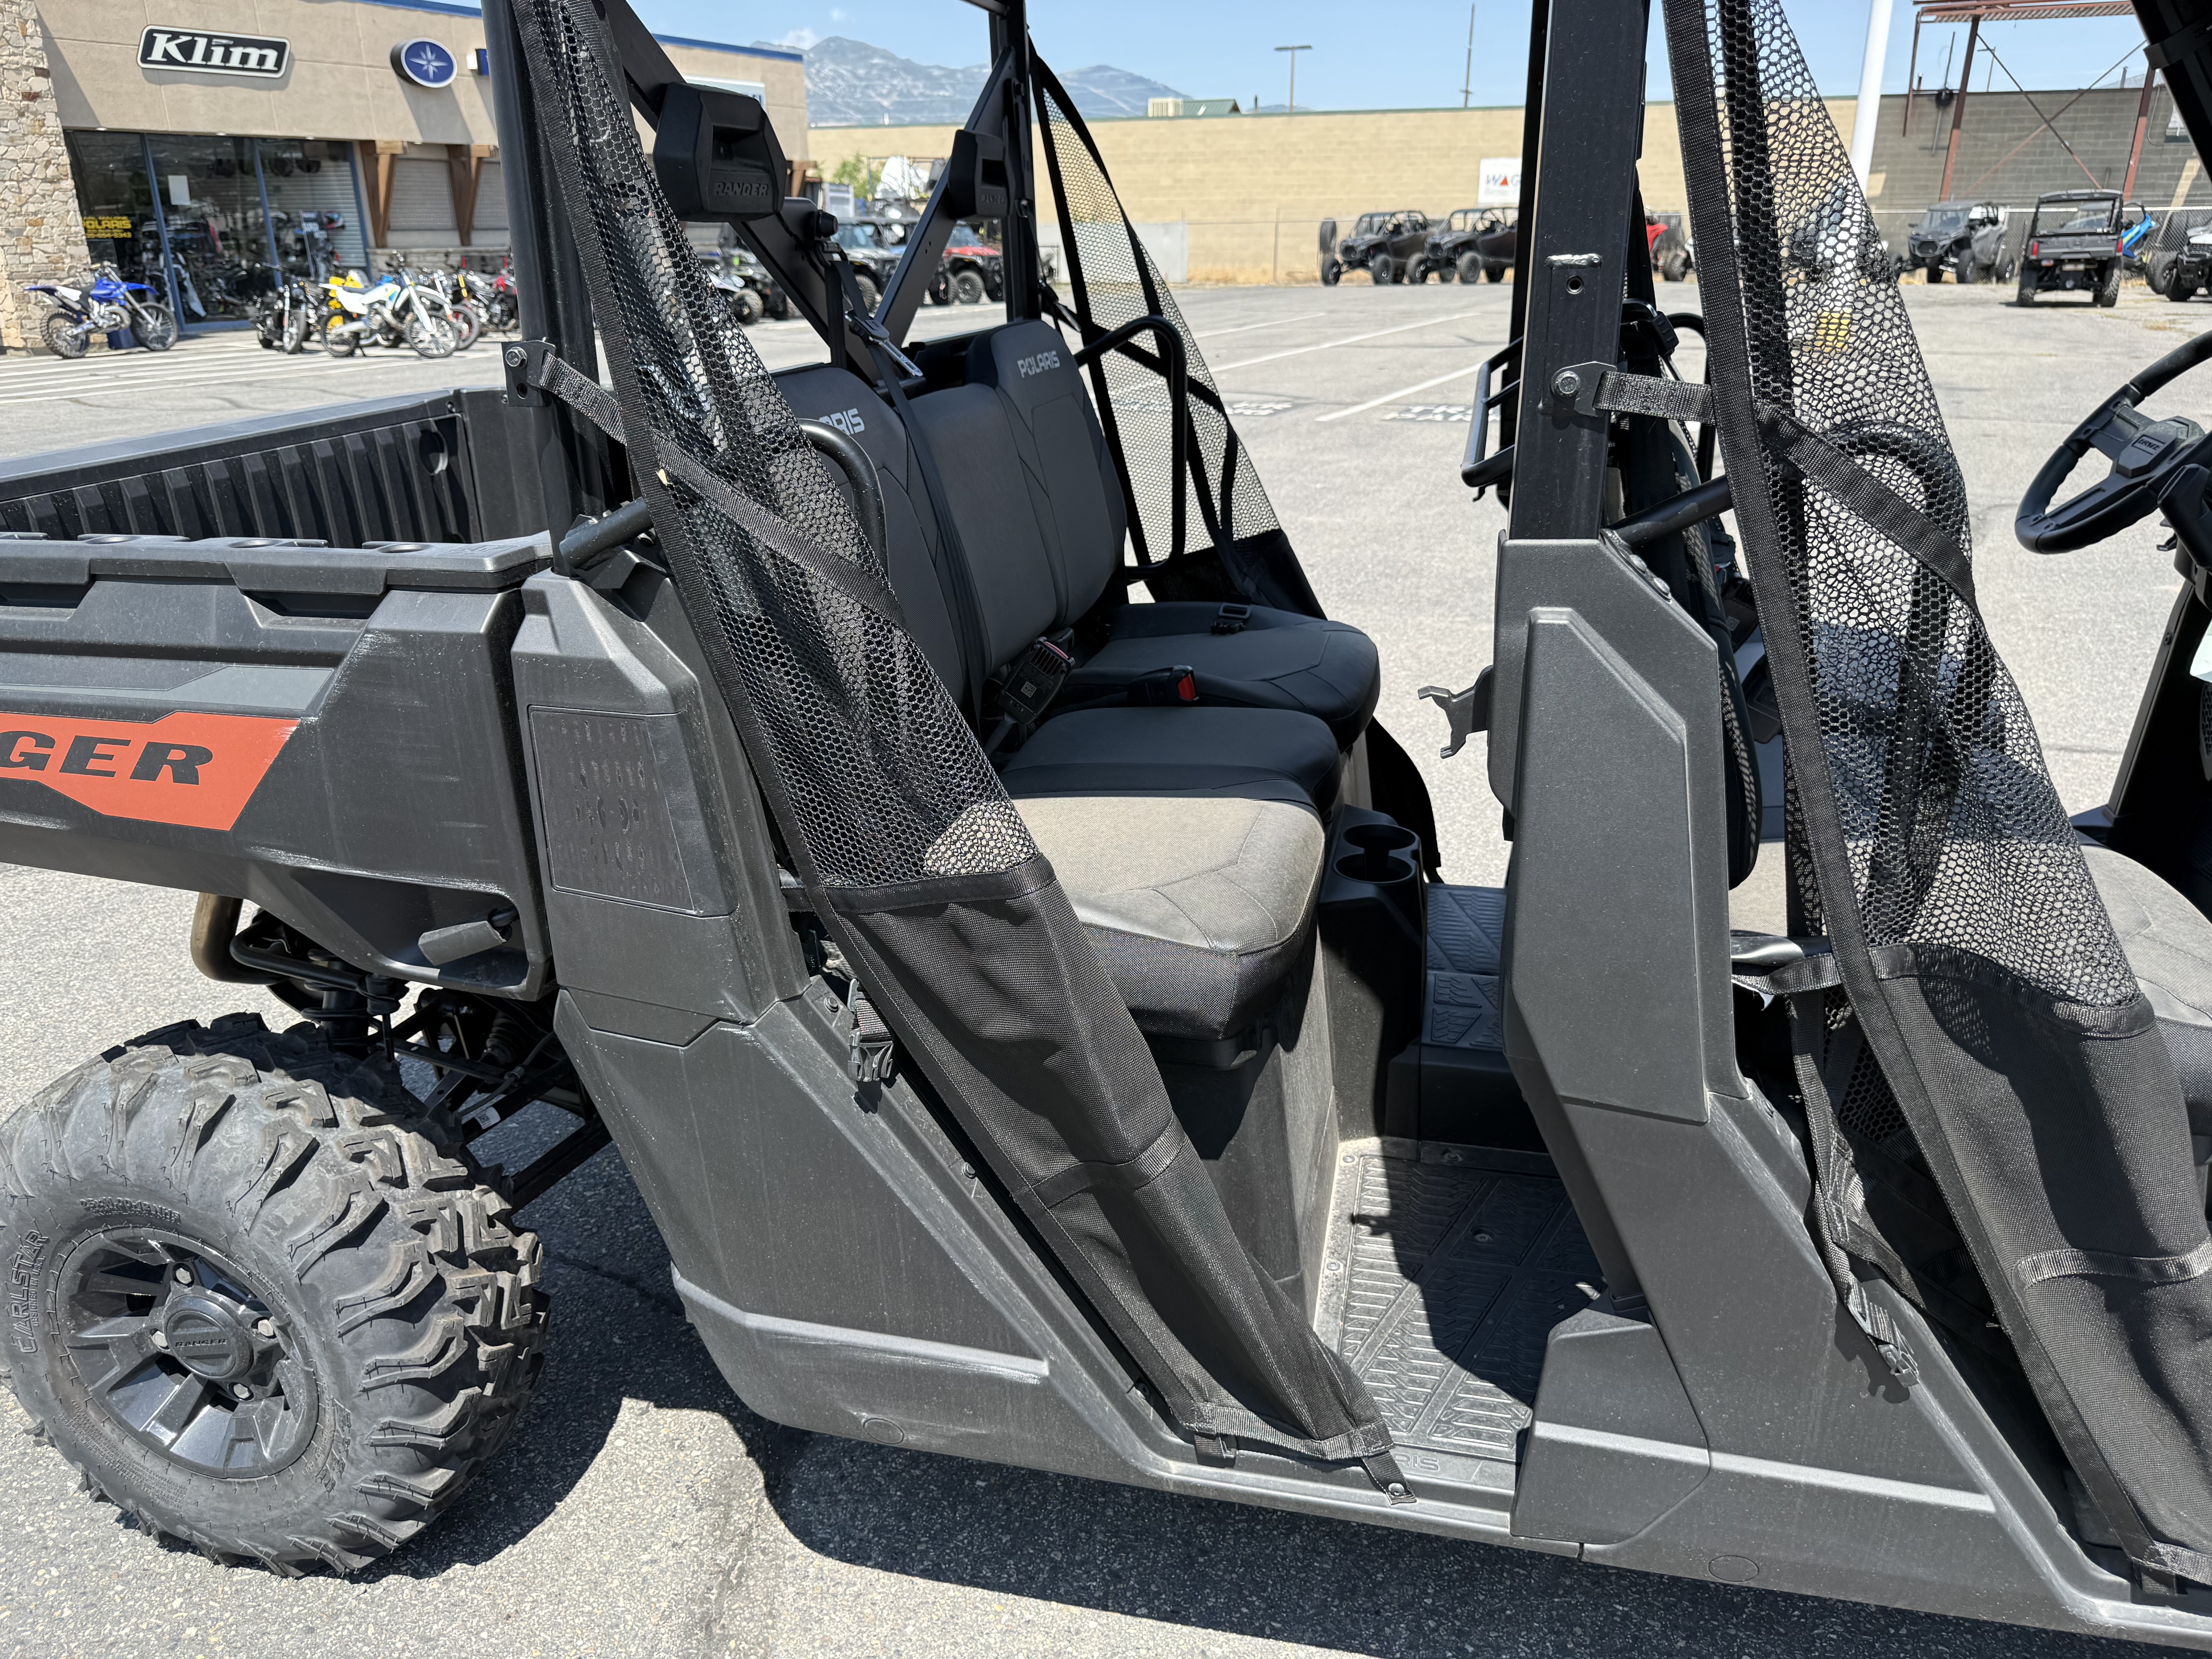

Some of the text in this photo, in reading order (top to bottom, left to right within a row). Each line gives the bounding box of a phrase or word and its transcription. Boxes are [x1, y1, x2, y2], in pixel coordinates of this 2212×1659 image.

[714, 181, 769, 196] RANGER
[1017, 350, 1061, 378] POLARIS
[11, 1230, 50, 1353] CARLSTAR
[30, 1278, 39, 1286] IN
[29, 1289, 40, 1328] DESIGNED
[175, 1338, 228, 1347] RANGER
